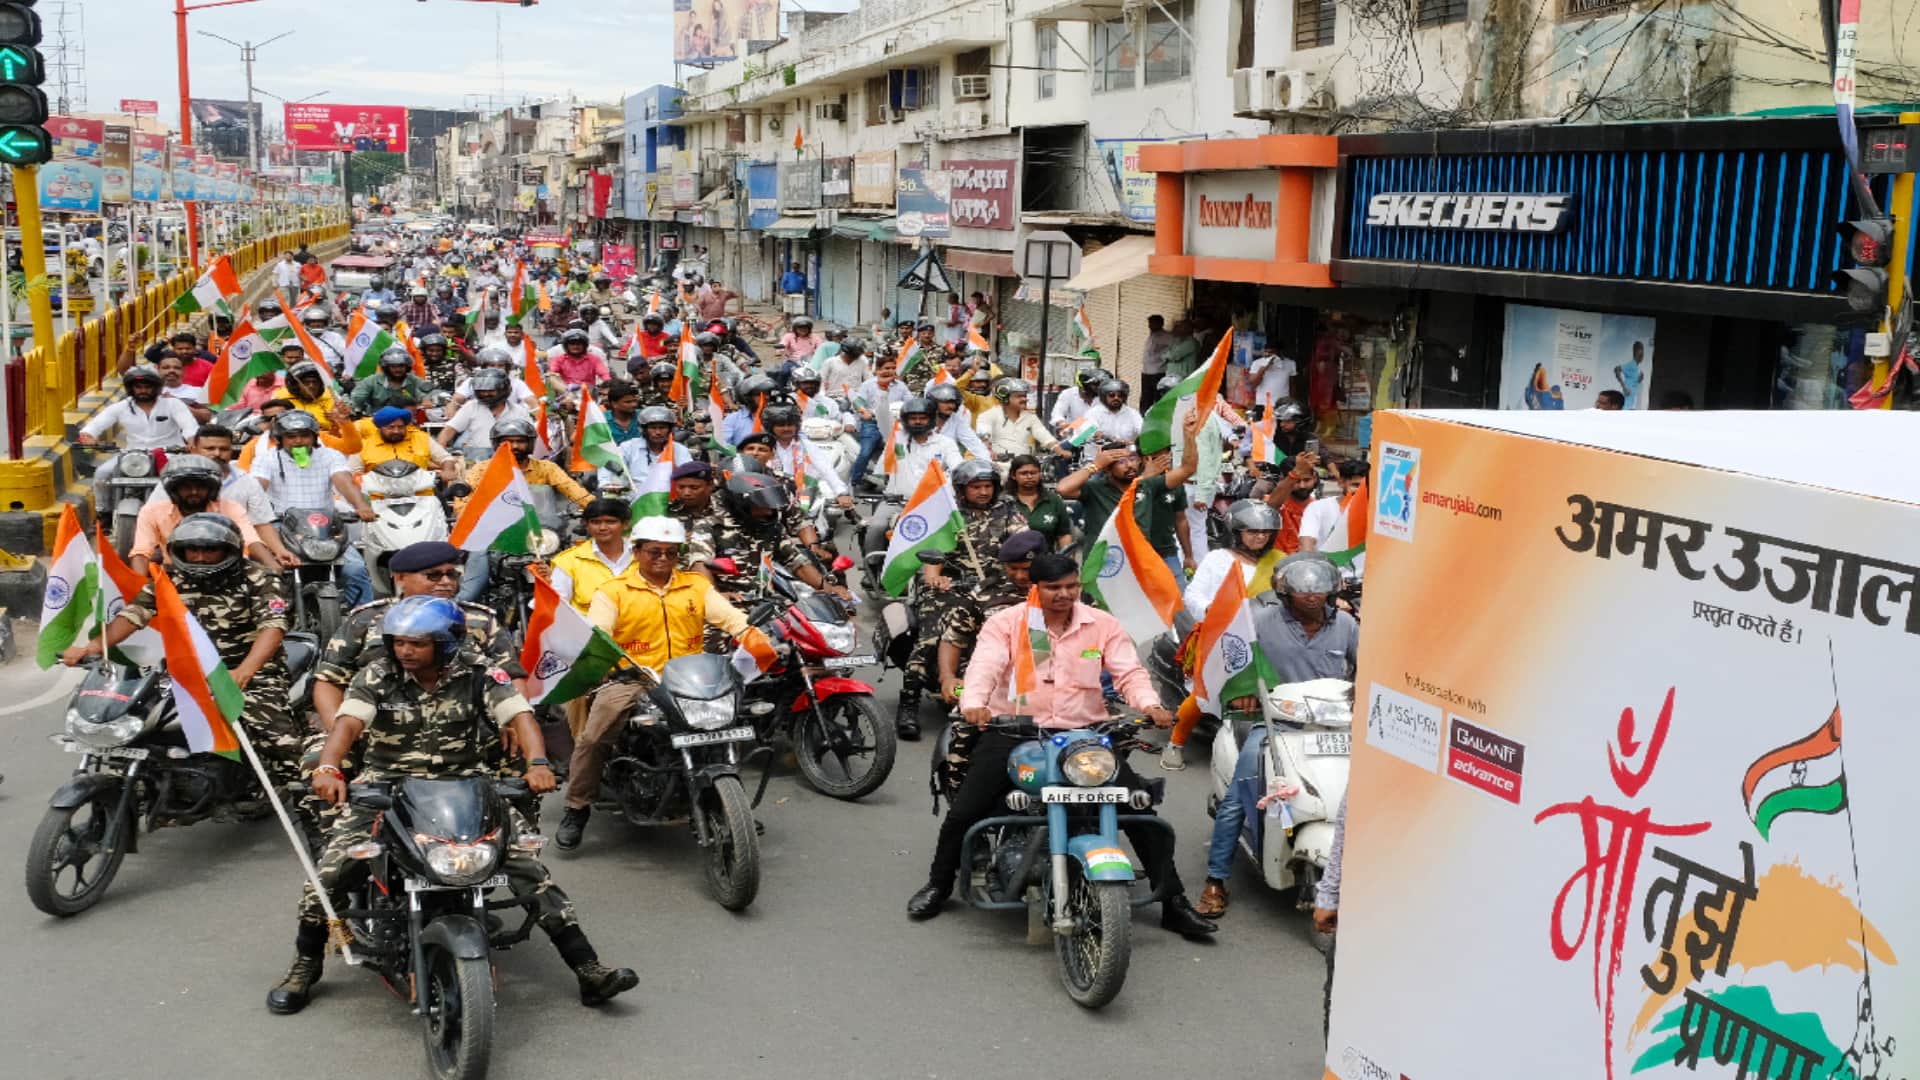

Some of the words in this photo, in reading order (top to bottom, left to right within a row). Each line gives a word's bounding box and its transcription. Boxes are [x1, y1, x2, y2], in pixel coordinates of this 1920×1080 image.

[1366, 194, 1568, 231] SKECHERS
[1422, 490, 1502, 521] amarujala.com
[1555, 493, 1712, 581] अमर
[1692, 600, 1733, 628] प्रस्तुत
[1736, 611, 1779, 639] करते
[1453, 759, 1515, 793] advance
[1047, 793, 1072, 802] AIR
[1078, 793, 1125, 802] FORCE
[1640, 841, 1758, 996] तुझे
